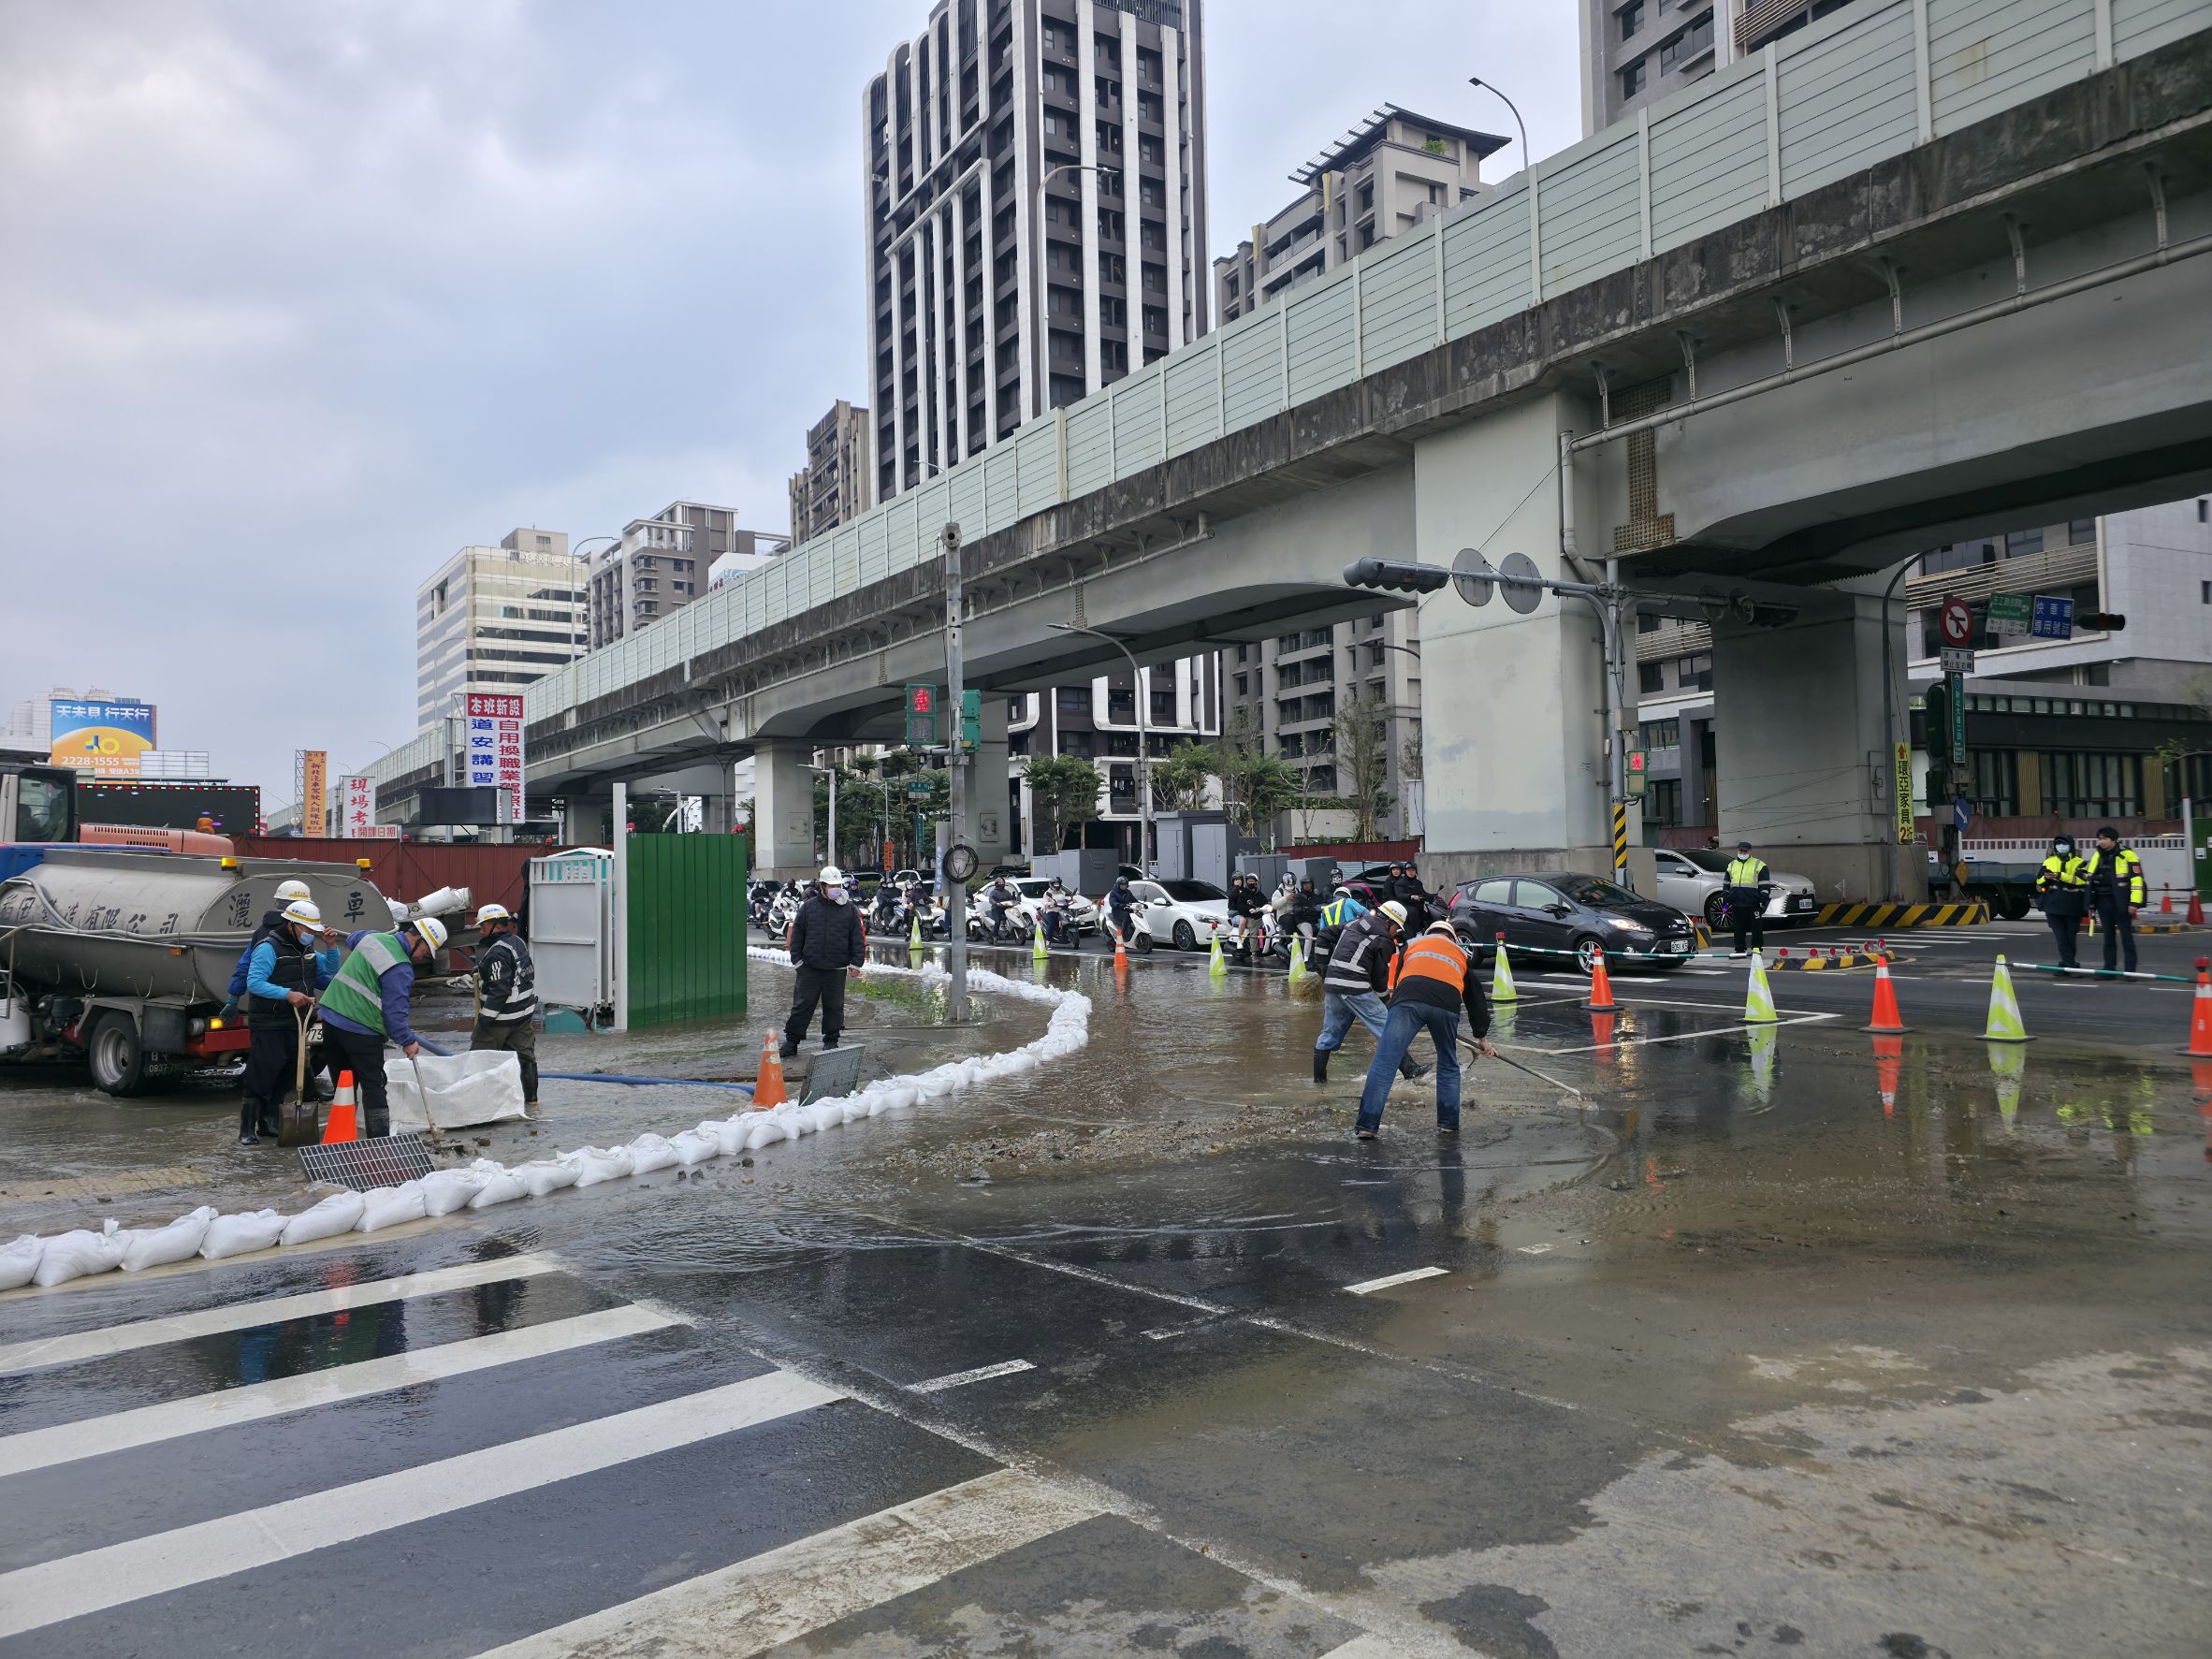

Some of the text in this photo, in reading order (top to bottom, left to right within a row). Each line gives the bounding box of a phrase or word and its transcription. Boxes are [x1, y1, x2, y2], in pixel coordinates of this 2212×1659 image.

[471, 697, 520, 716] 本班新設
[62, 756, 120, 765] 2228-1555
[472, 718, 494, 783] 道安講習
[1899, 761, 1910, 824] 環亞家具
